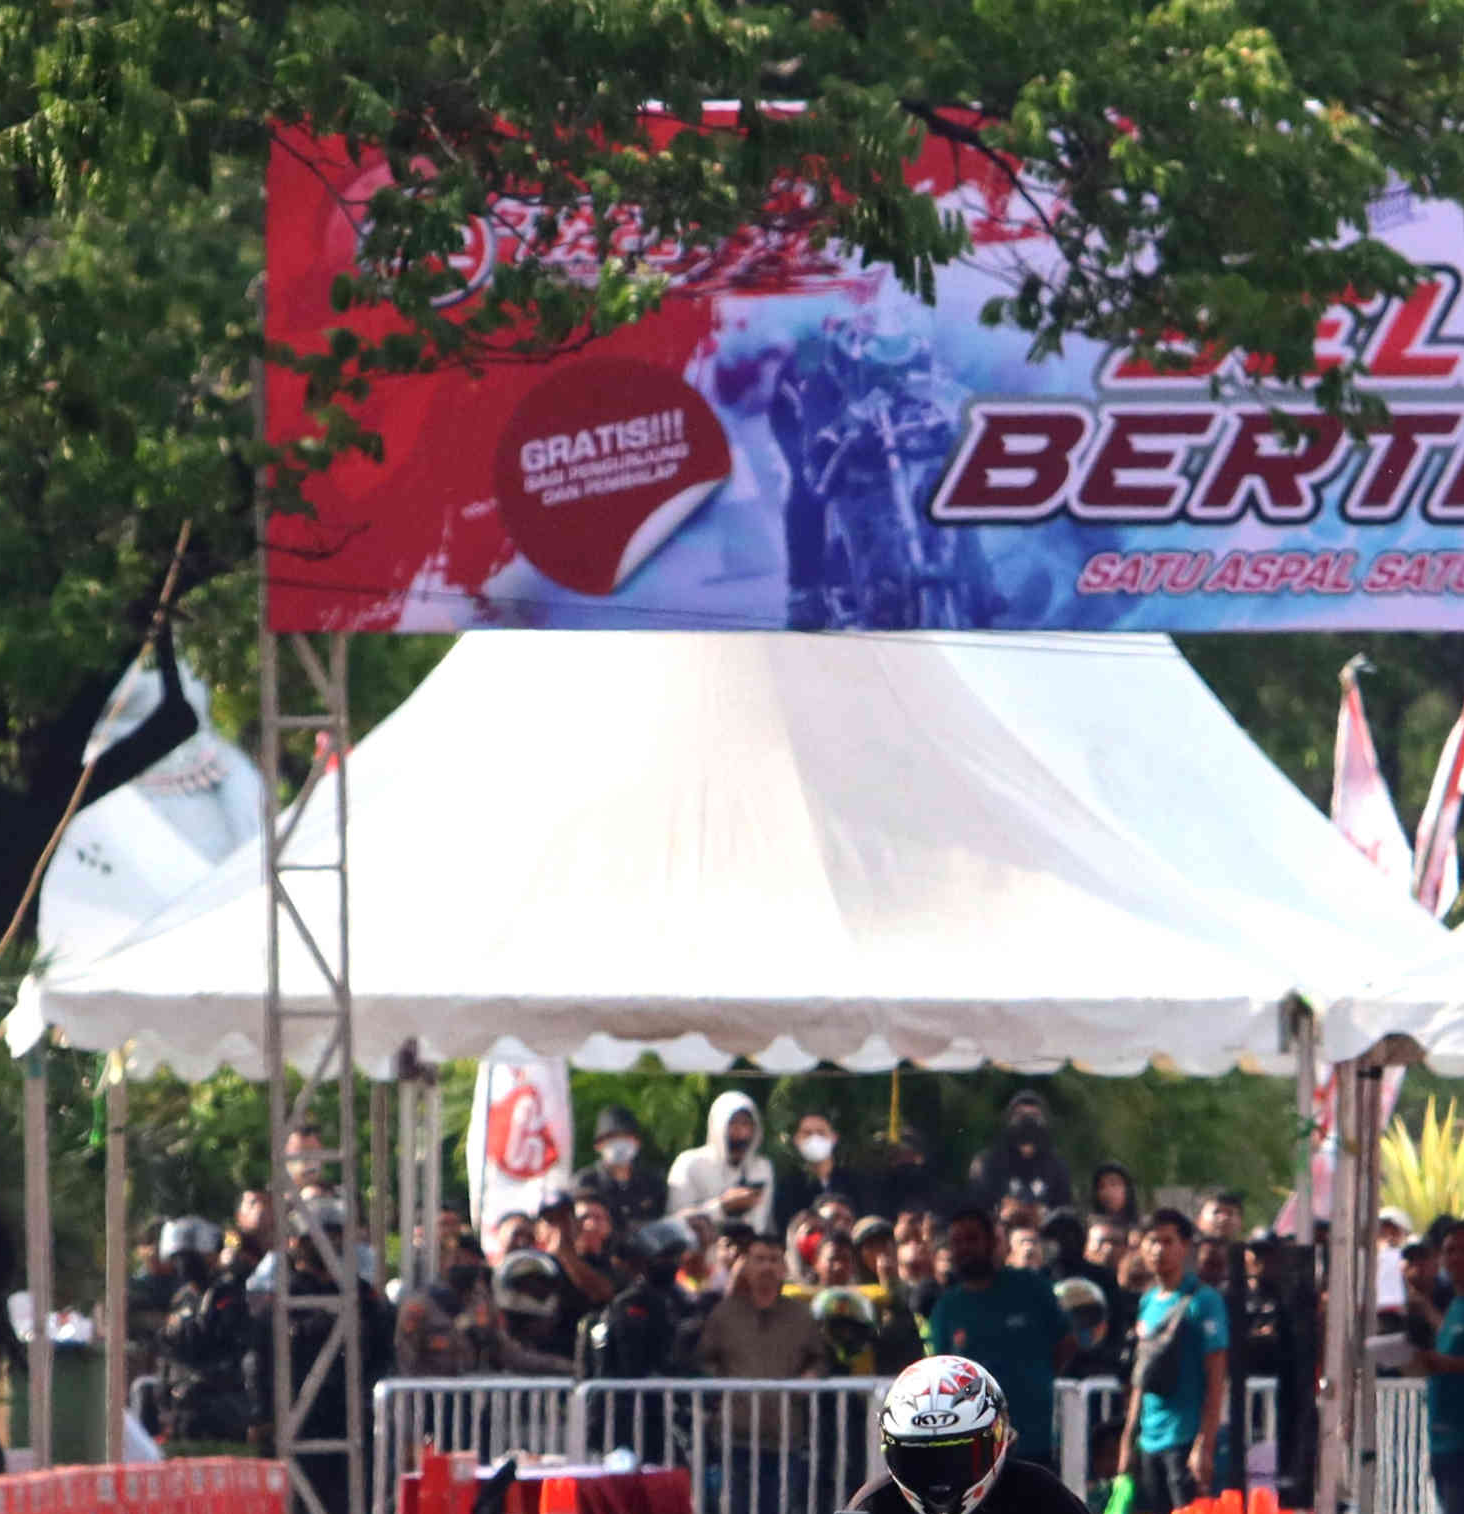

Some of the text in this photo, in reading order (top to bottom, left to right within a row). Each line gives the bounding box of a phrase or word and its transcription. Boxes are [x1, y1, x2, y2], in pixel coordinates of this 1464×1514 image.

[520, 408, 684, 472] GRATIS!!!
[1077, 552, 1210, 595] SATU
[1203, 552, 1354, 595] ASPAL
